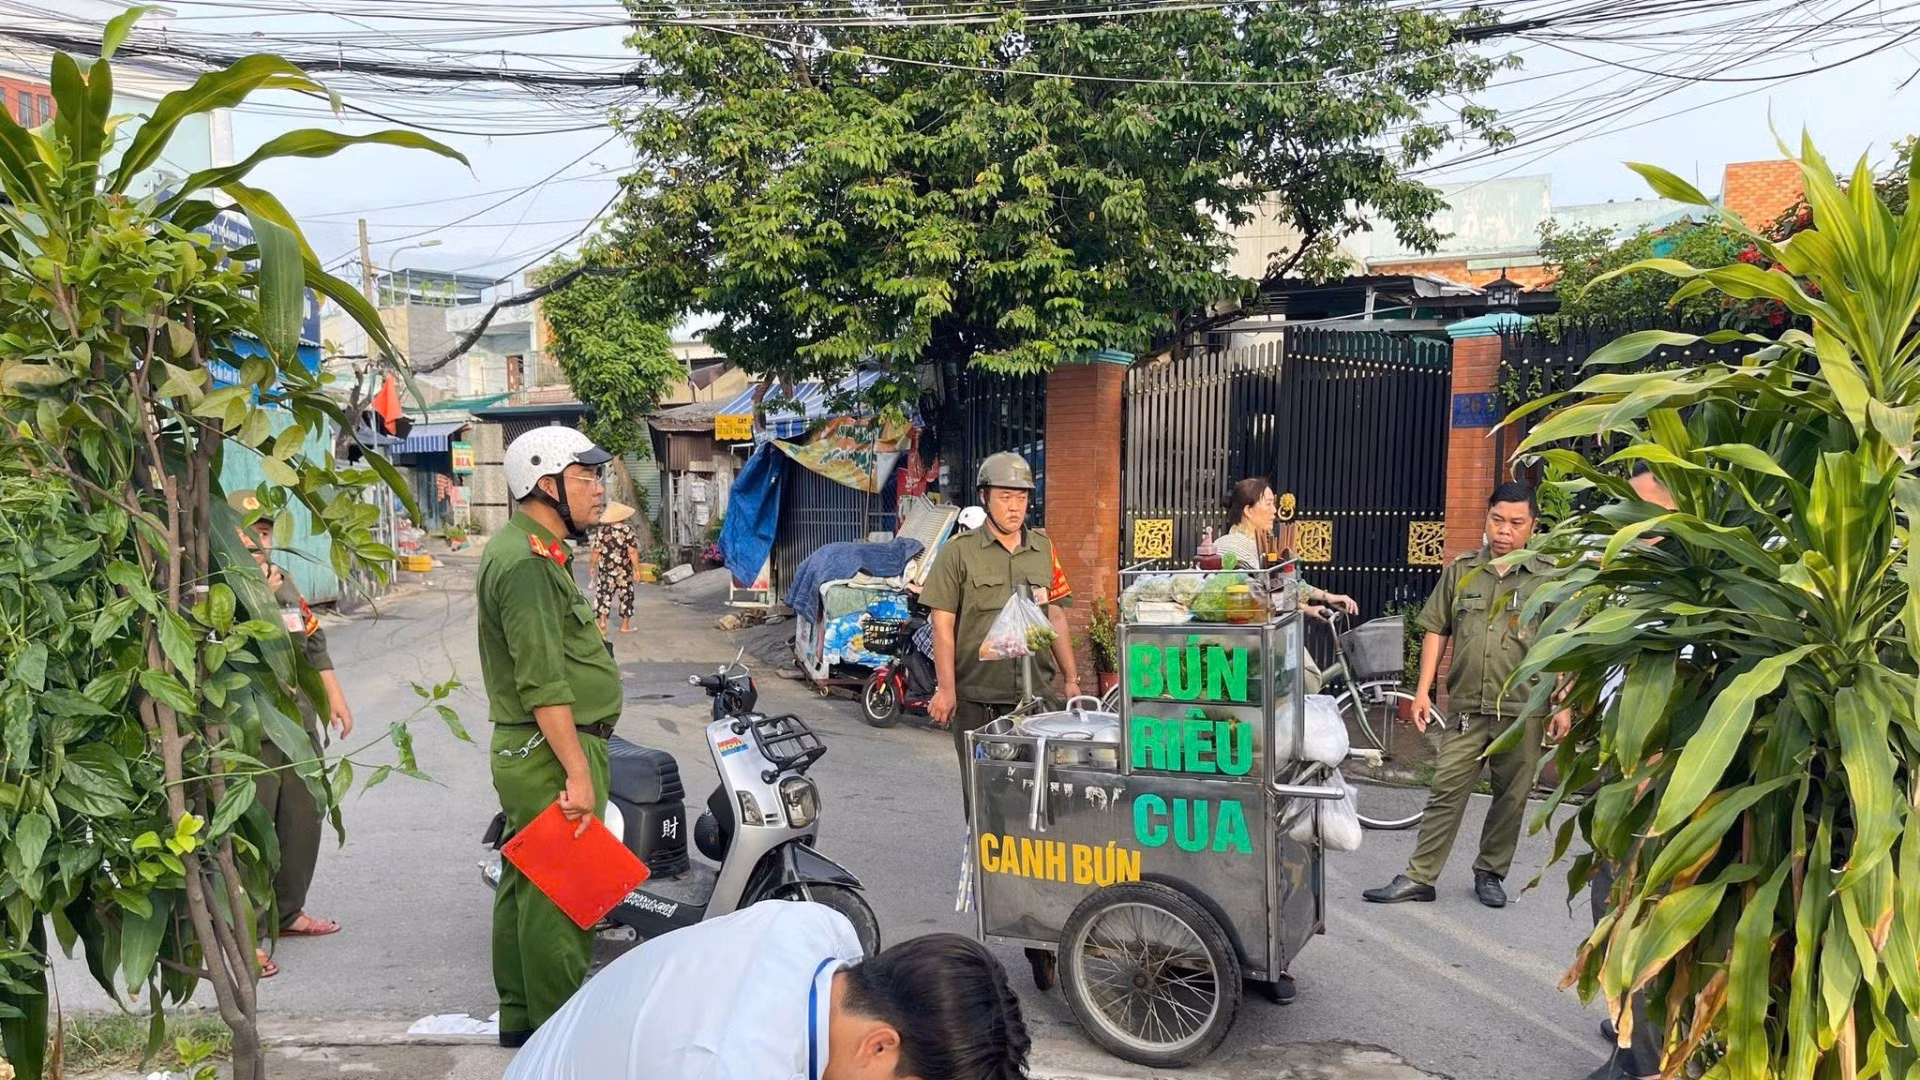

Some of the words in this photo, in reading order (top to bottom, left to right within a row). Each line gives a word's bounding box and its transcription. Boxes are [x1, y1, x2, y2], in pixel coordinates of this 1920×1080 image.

[1129, 633, 1248, 702] BÚN
[1131, 707, 1253, 776] RIÊU
[661, 815, 679, 839] 財
[1133, 793, 1252, 854] CUA
[980, 832, 1067, 882] CANH
[1072, 840, 1141, 887] BÚN
